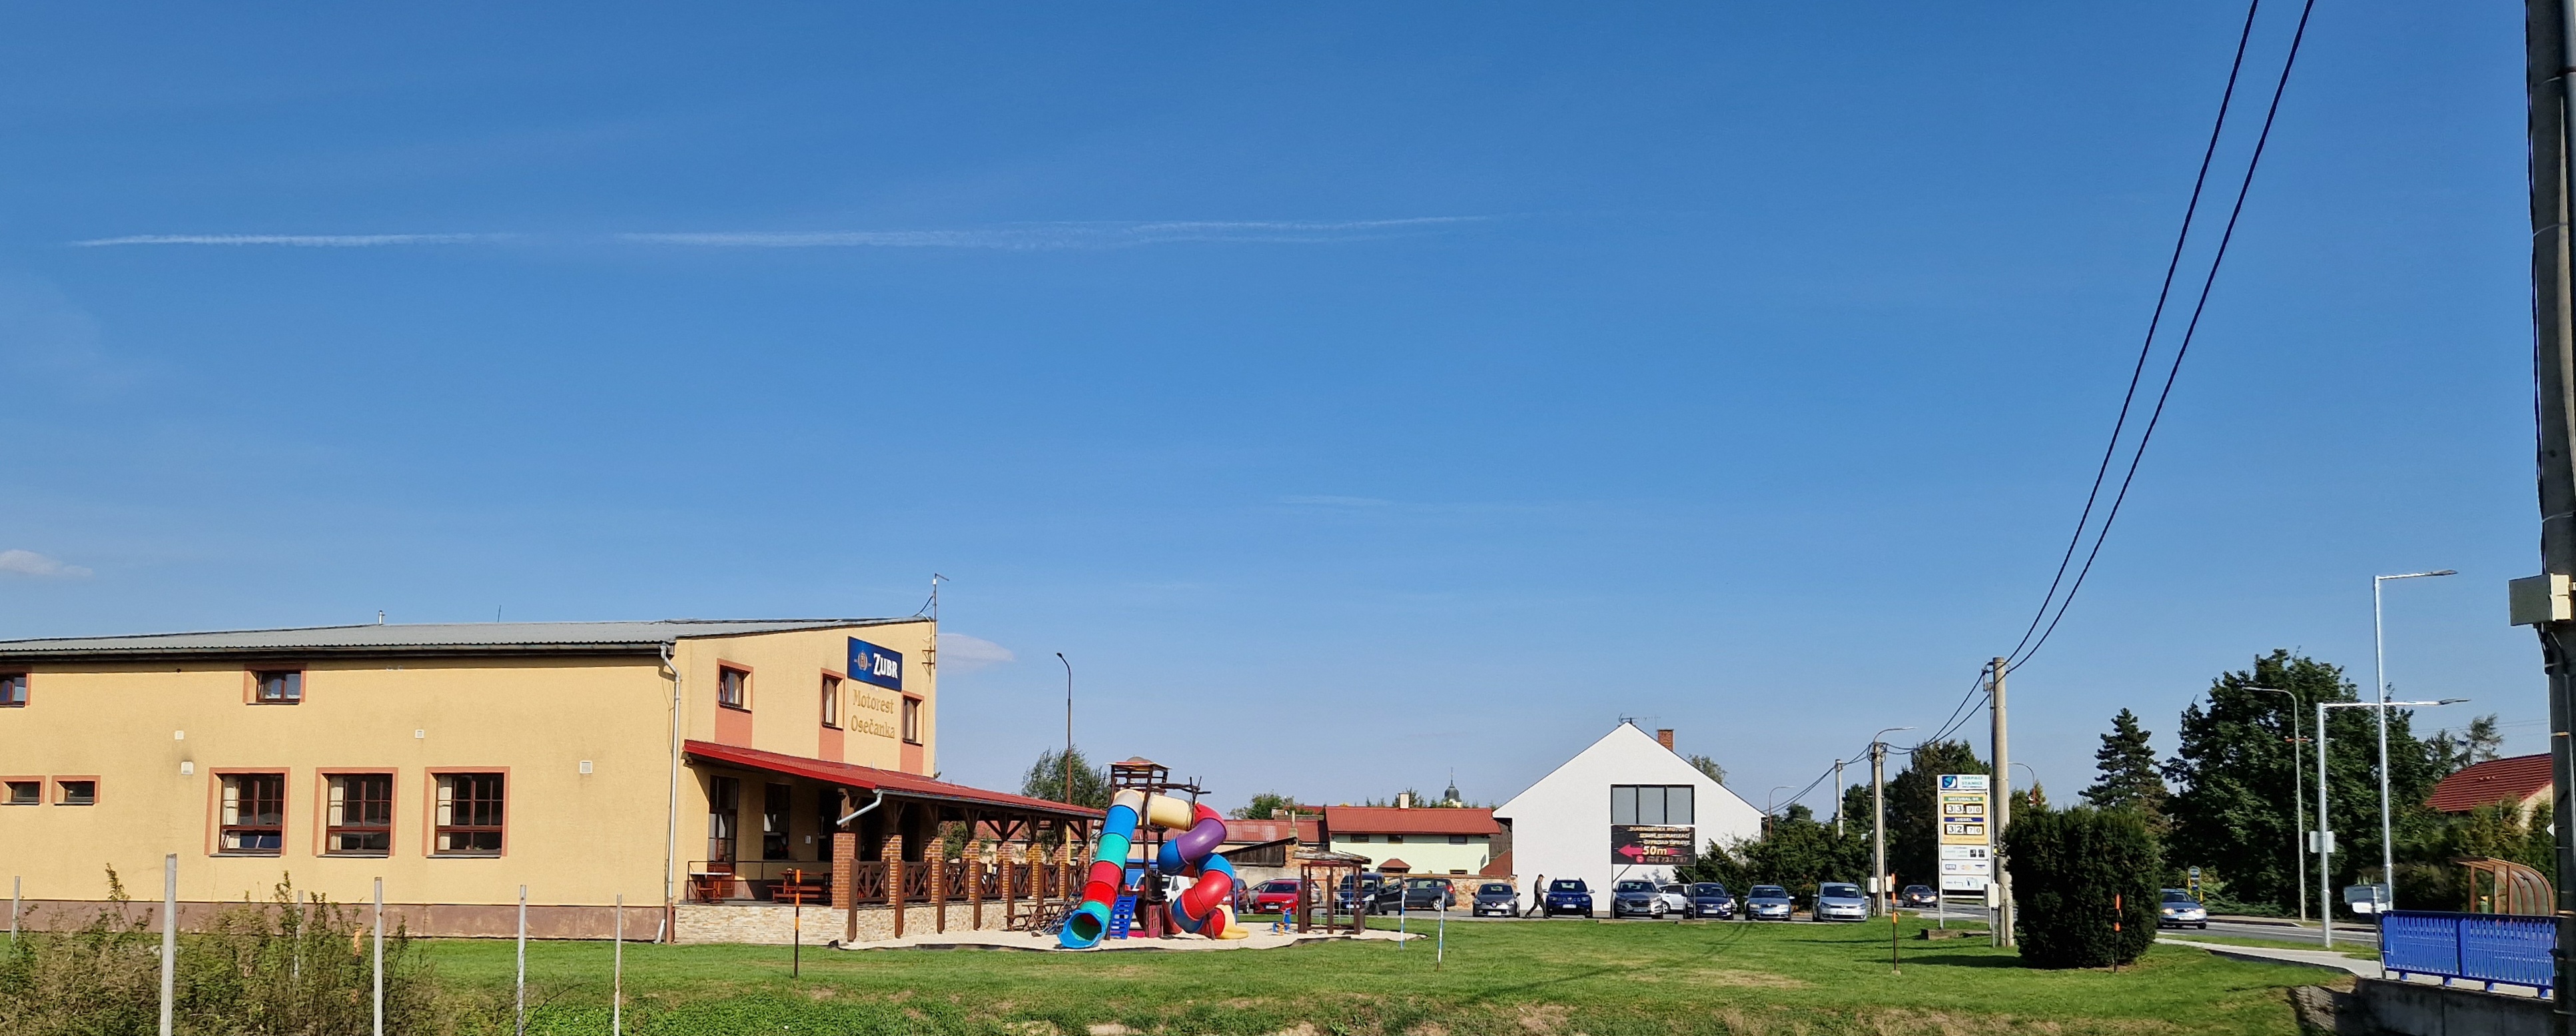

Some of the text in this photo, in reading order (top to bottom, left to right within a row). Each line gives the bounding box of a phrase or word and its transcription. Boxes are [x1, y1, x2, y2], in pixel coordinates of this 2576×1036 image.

[873, 653, 898, 679] ZUBR
[853, 689, 894, 714] Motorest
[851, 714, 895, 739] Osečanka
[1642, 845, 1667, 855] 50m
